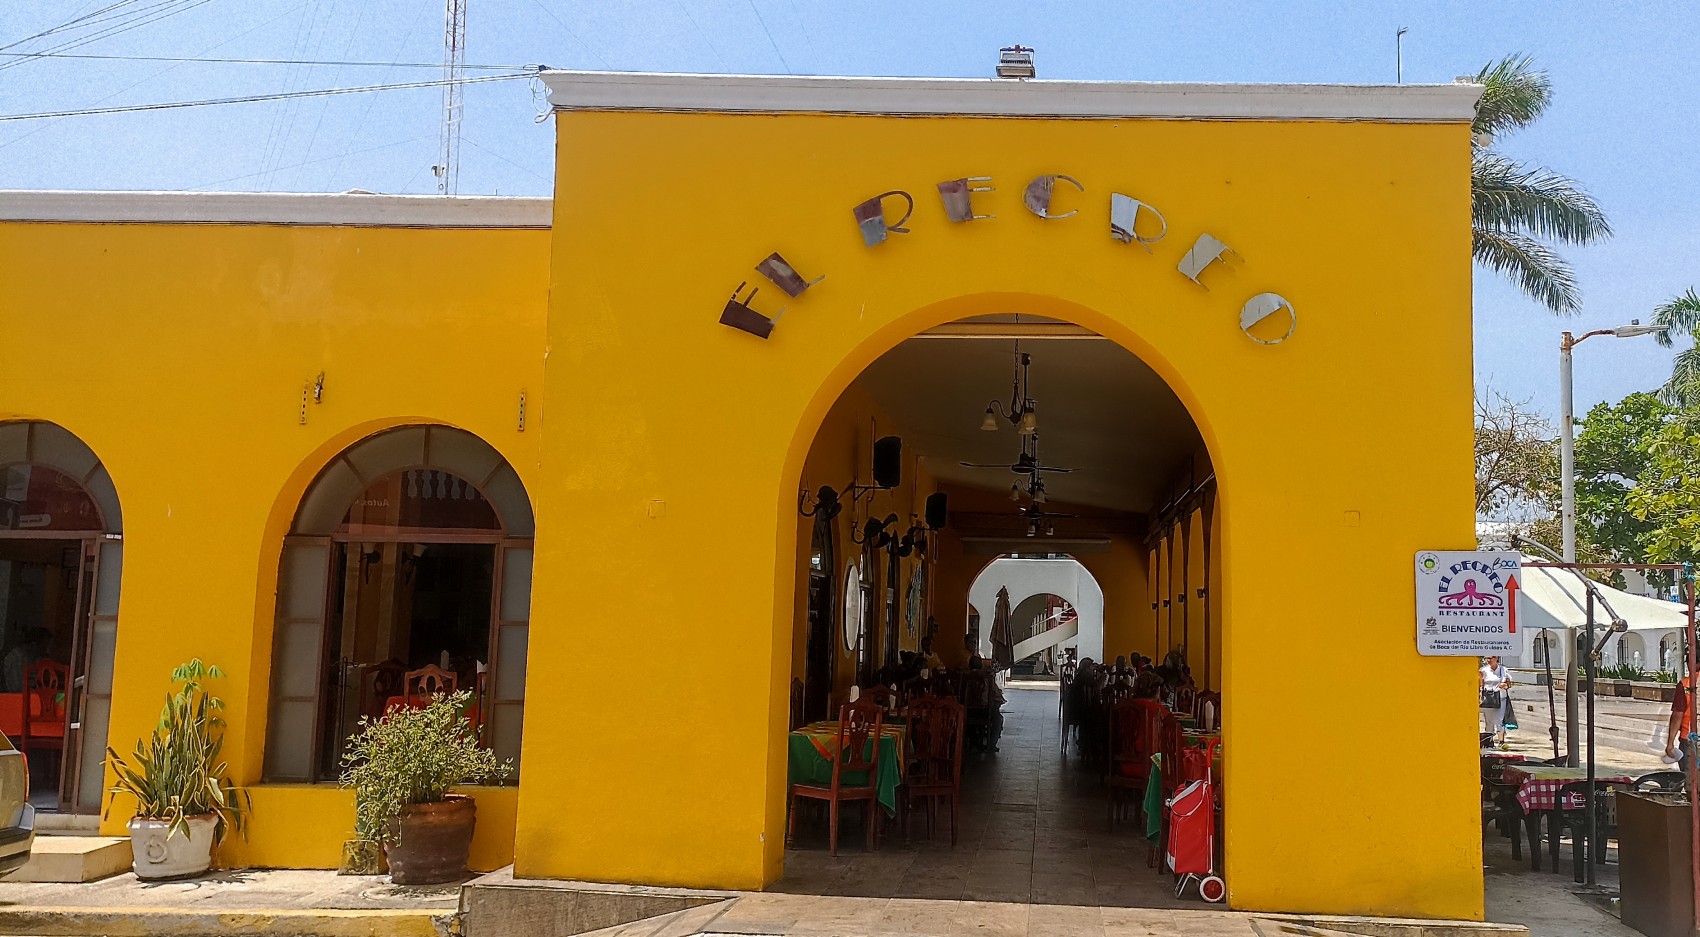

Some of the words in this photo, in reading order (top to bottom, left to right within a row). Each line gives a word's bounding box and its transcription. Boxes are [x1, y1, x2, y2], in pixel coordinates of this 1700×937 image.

[719, 252, 825, 340] EL
[853, 174, 1297, 346] RECREO
[1438, 575, 1453, 593] EL
[1449, 560, 1504, 594] RECREO
[1441, 624, 1504, 634] BIENVENIDOS
